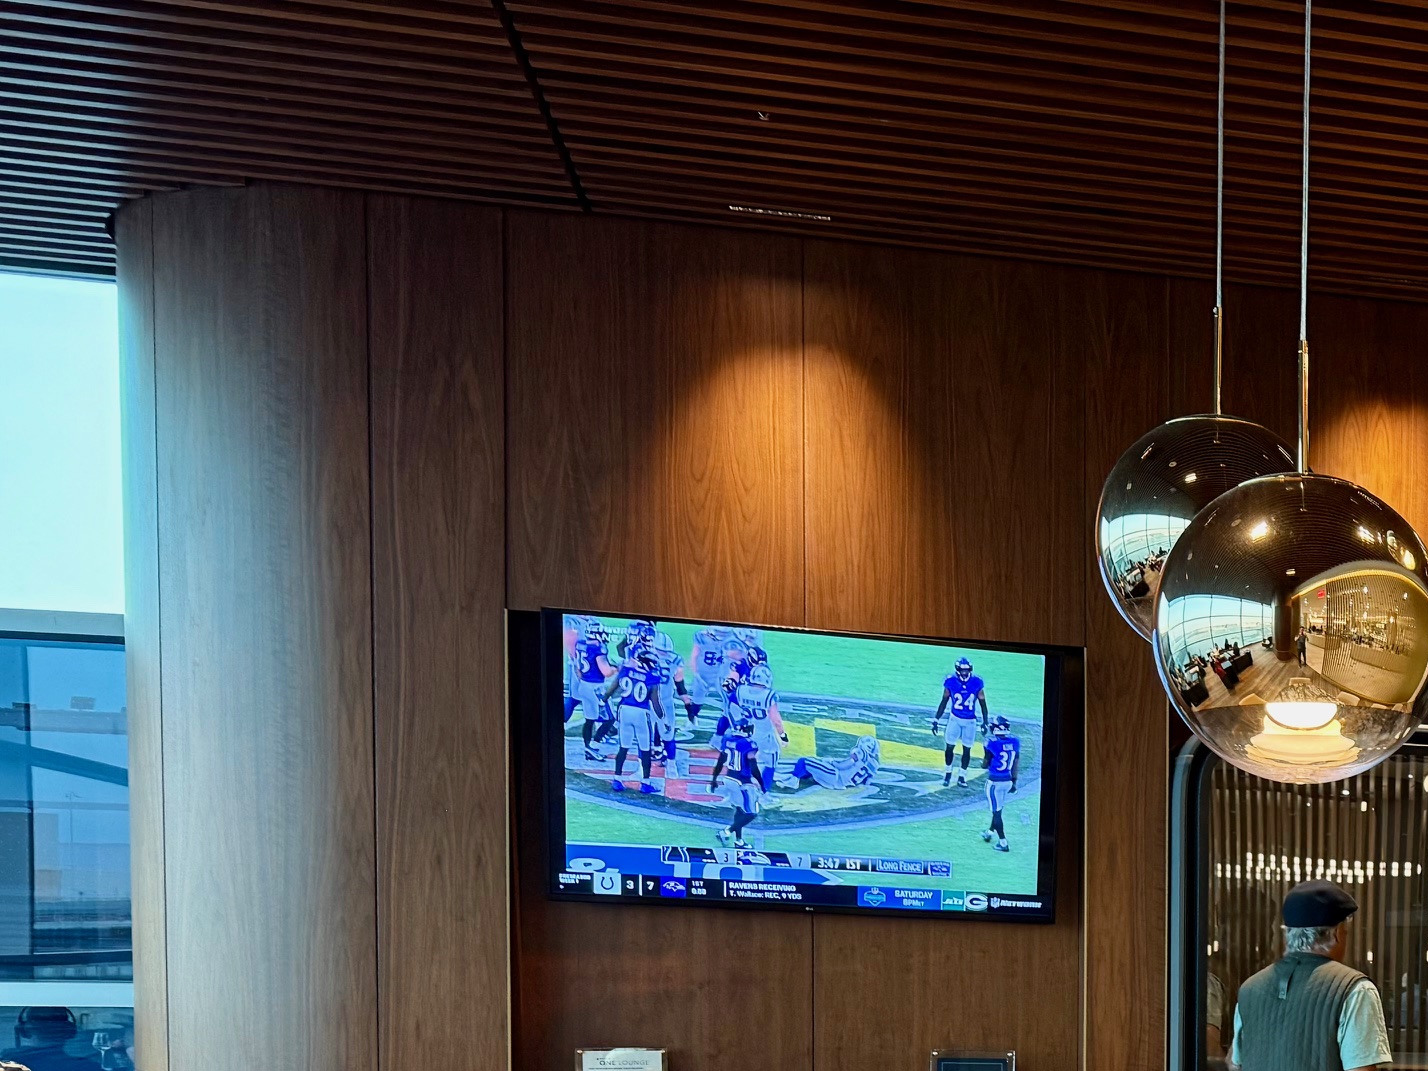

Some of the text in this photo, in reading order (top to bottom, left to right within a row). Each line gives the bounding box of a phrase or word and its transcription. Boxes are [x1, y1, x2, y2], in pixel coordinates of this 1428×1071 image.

[619, 676, 648, 702] 90
[953, 692, 975, 711] 24
[996, 750, 1016, 771] 31
[723, 852, 730, 863] 3
[797, 856, 803, 868] 7
[817, 857, 840, 869] 3:47
[878, 859, 899, 871] LONG
[899, 861, 922, 873] FENCE
[626, 880, 635, 890] 3
[646, 880, 655, 891] 7
[728, 881, 797, 892] RAVENS RECEIVING
[787, 892, 802, 900] YDS
[894, 889, 933, 899] SATURDAY
